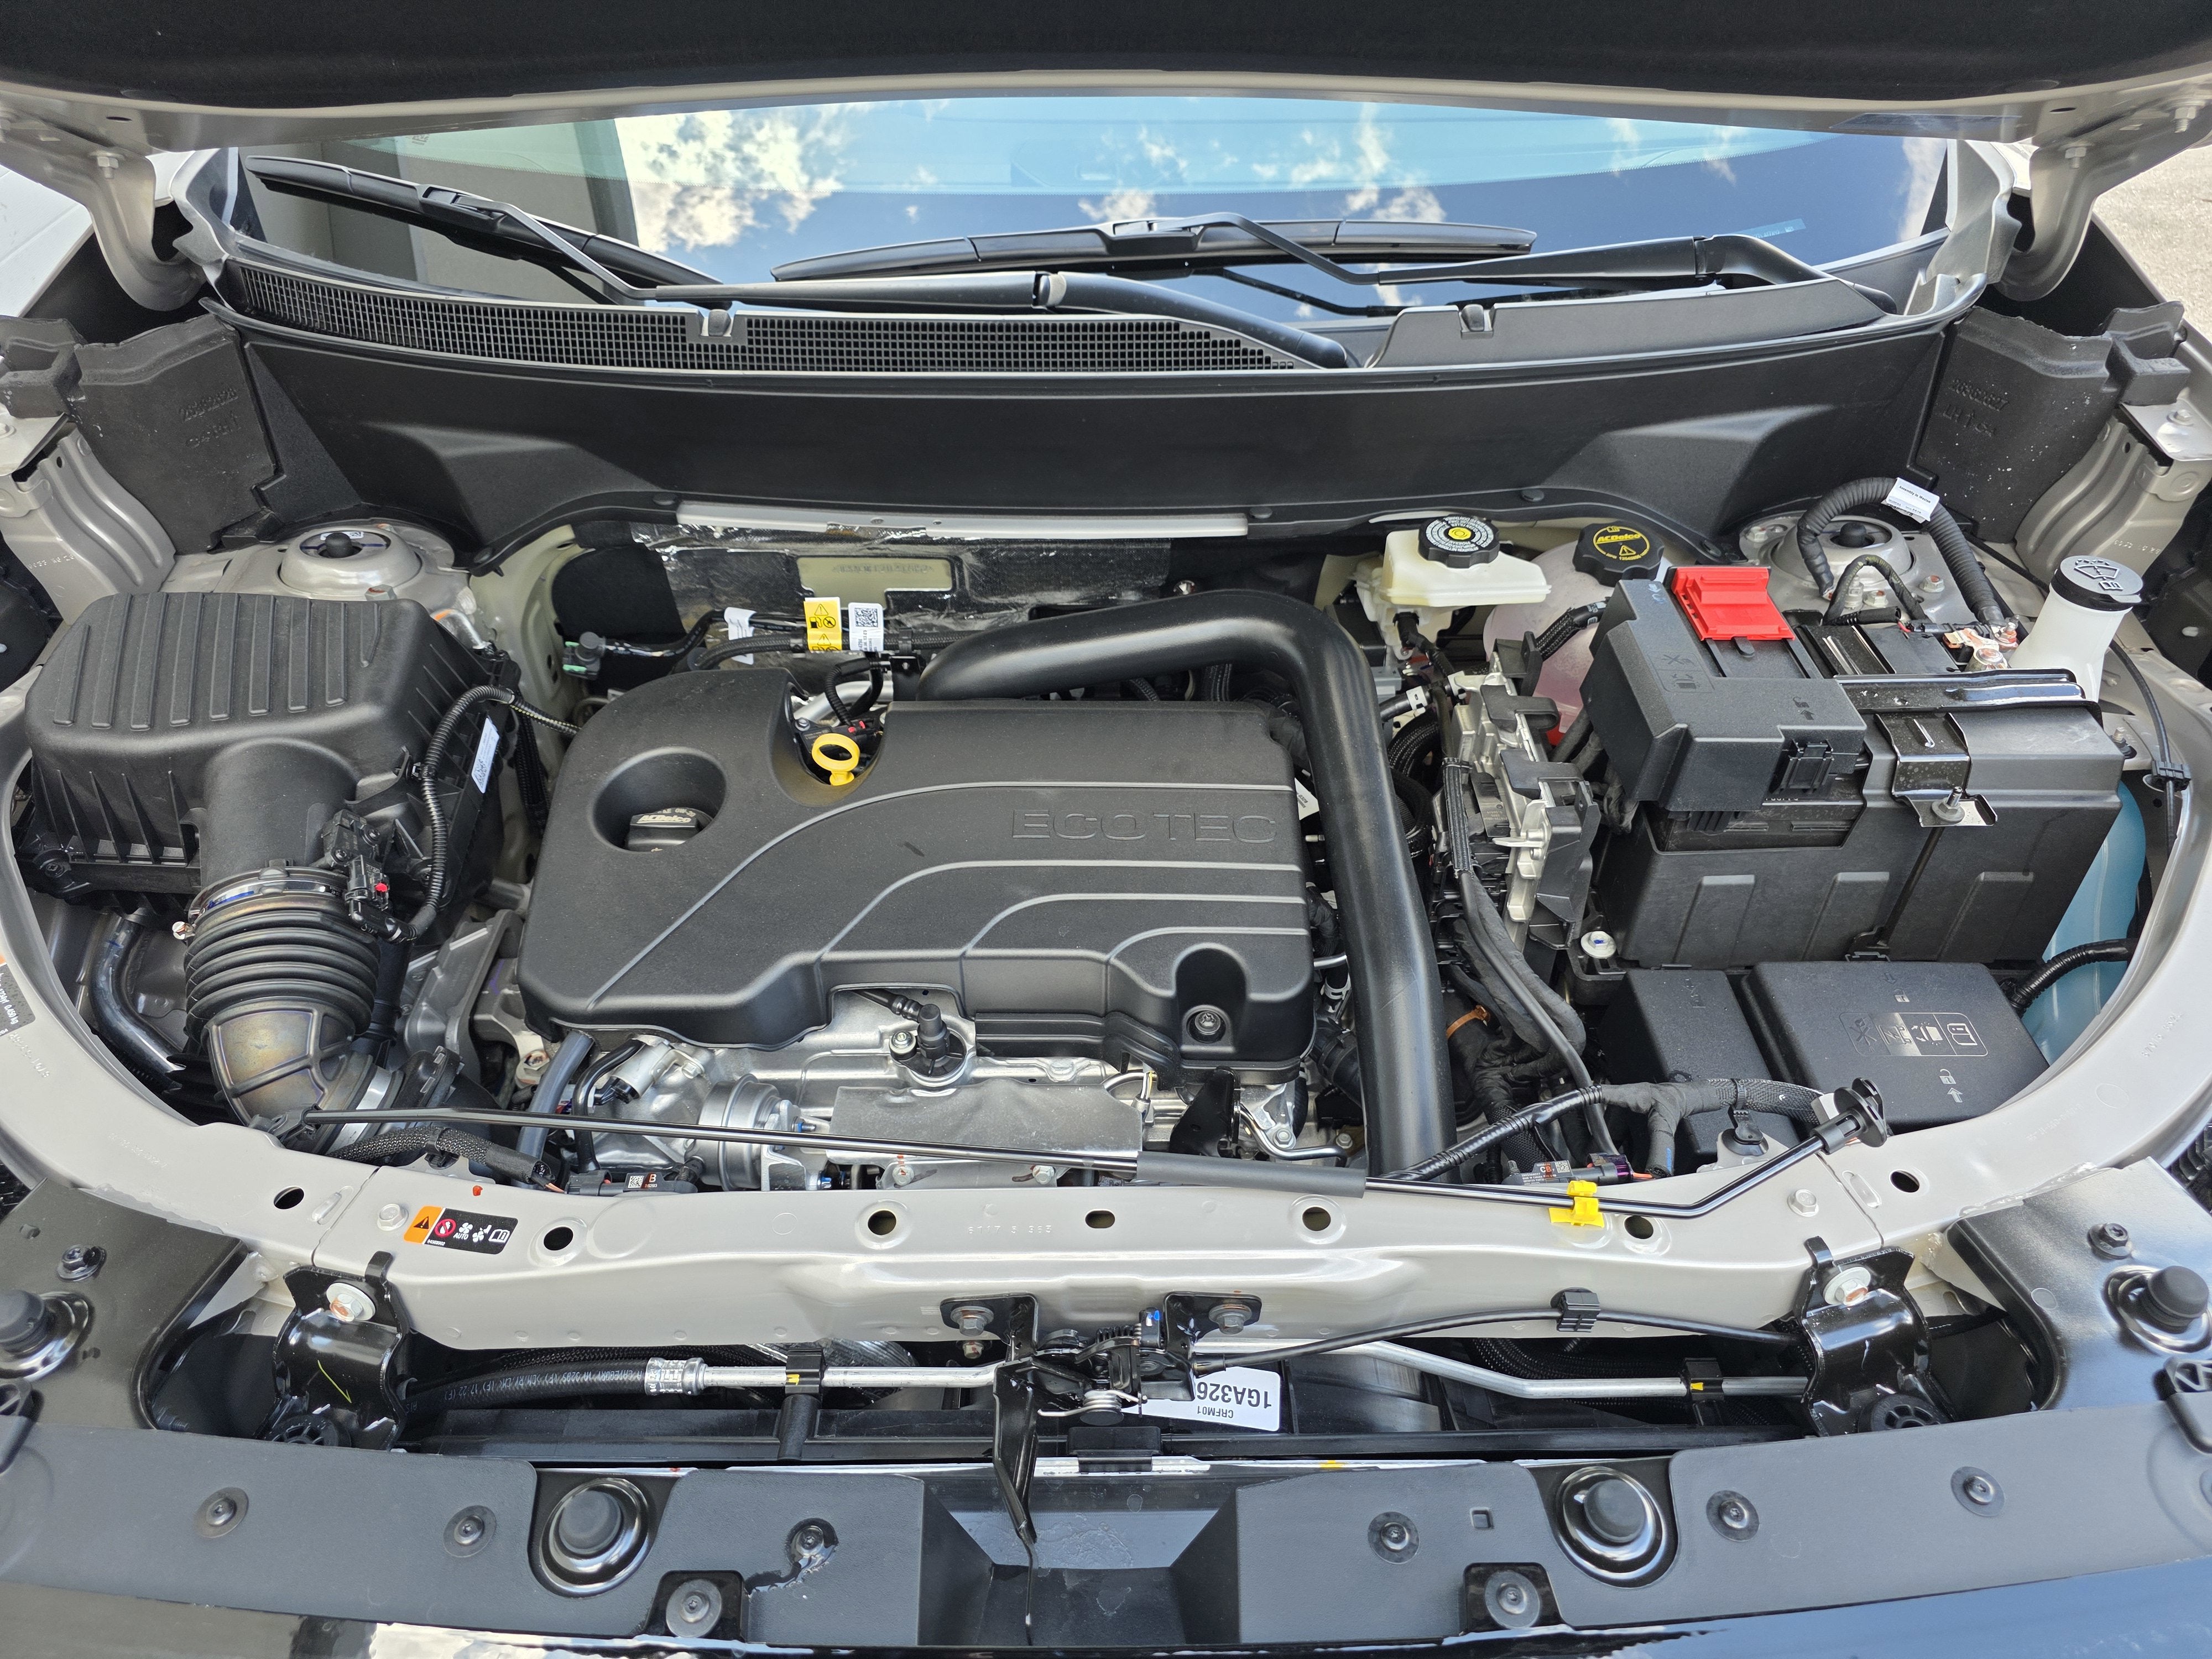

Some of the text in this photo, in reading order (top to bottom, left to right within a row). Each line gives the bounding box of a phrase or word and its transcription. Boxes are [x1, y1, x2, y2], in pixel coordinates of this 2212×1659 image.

[1597, 534, 1641, 542] ACDelco
[638, 815, 691, 823] ACDelco
[1011, 809, 1277, 843] ECOTEC
[649, 1173, 657, 1182] B
[453, 1232, 469, 1240] AUTO
[1197, 1381, 1272, 1410] 1GA326
[1197, 1405, 1234, 1419] CRFM01
